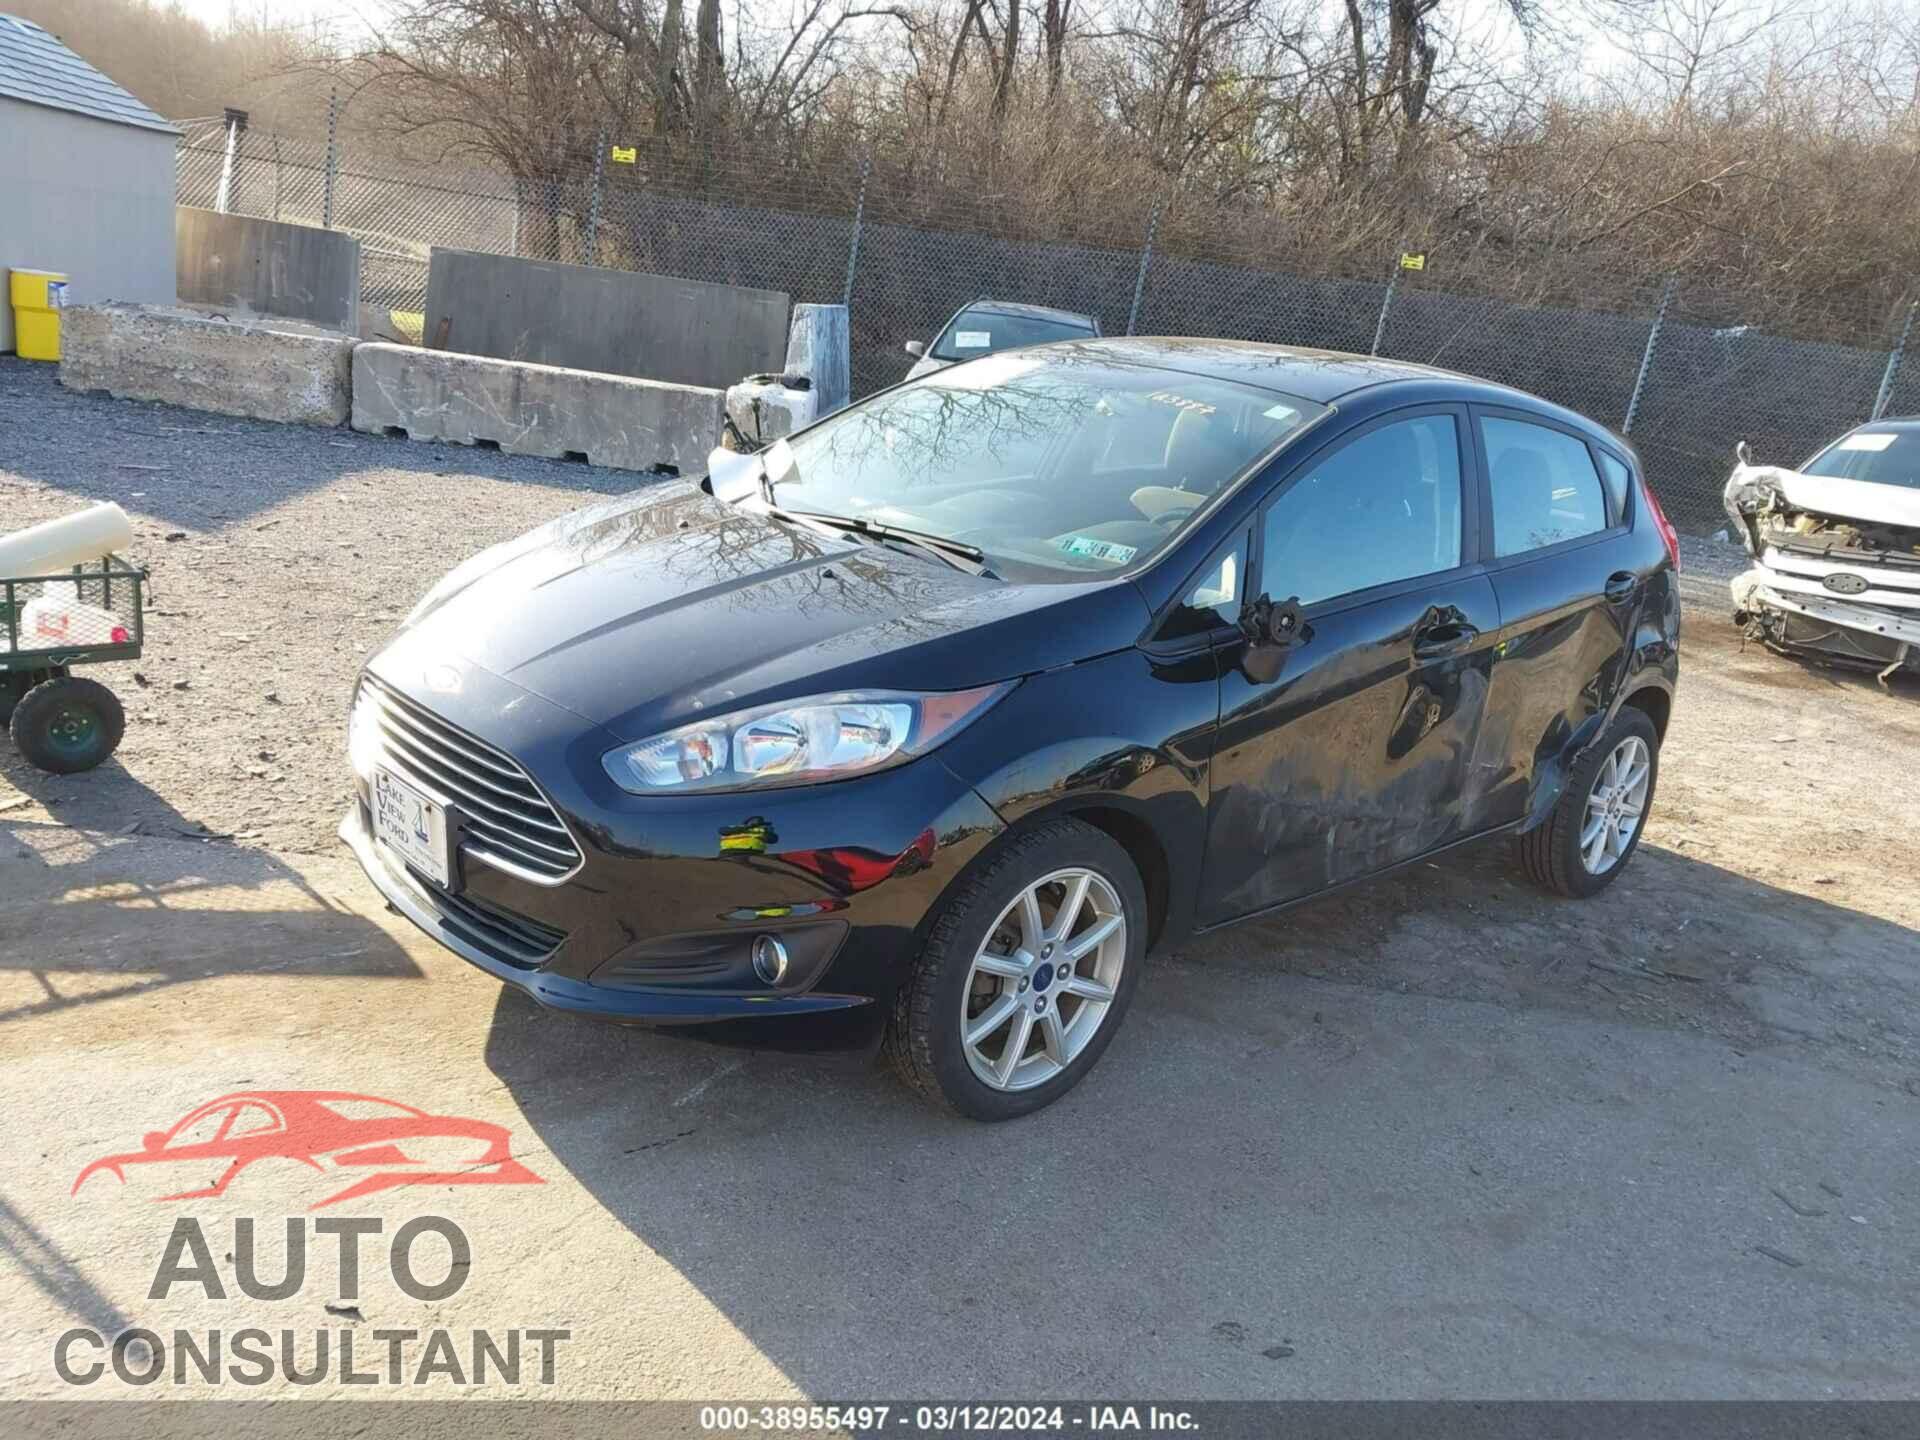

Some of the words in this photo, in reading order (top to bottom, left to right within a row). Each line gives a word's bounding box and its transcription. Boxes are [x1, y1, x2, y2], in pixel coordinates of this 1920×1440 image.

[376, 773, 405, 807] LAKE
[376, 791, 406, 824] VIEW
[379, 809, 409, 844] FORD
